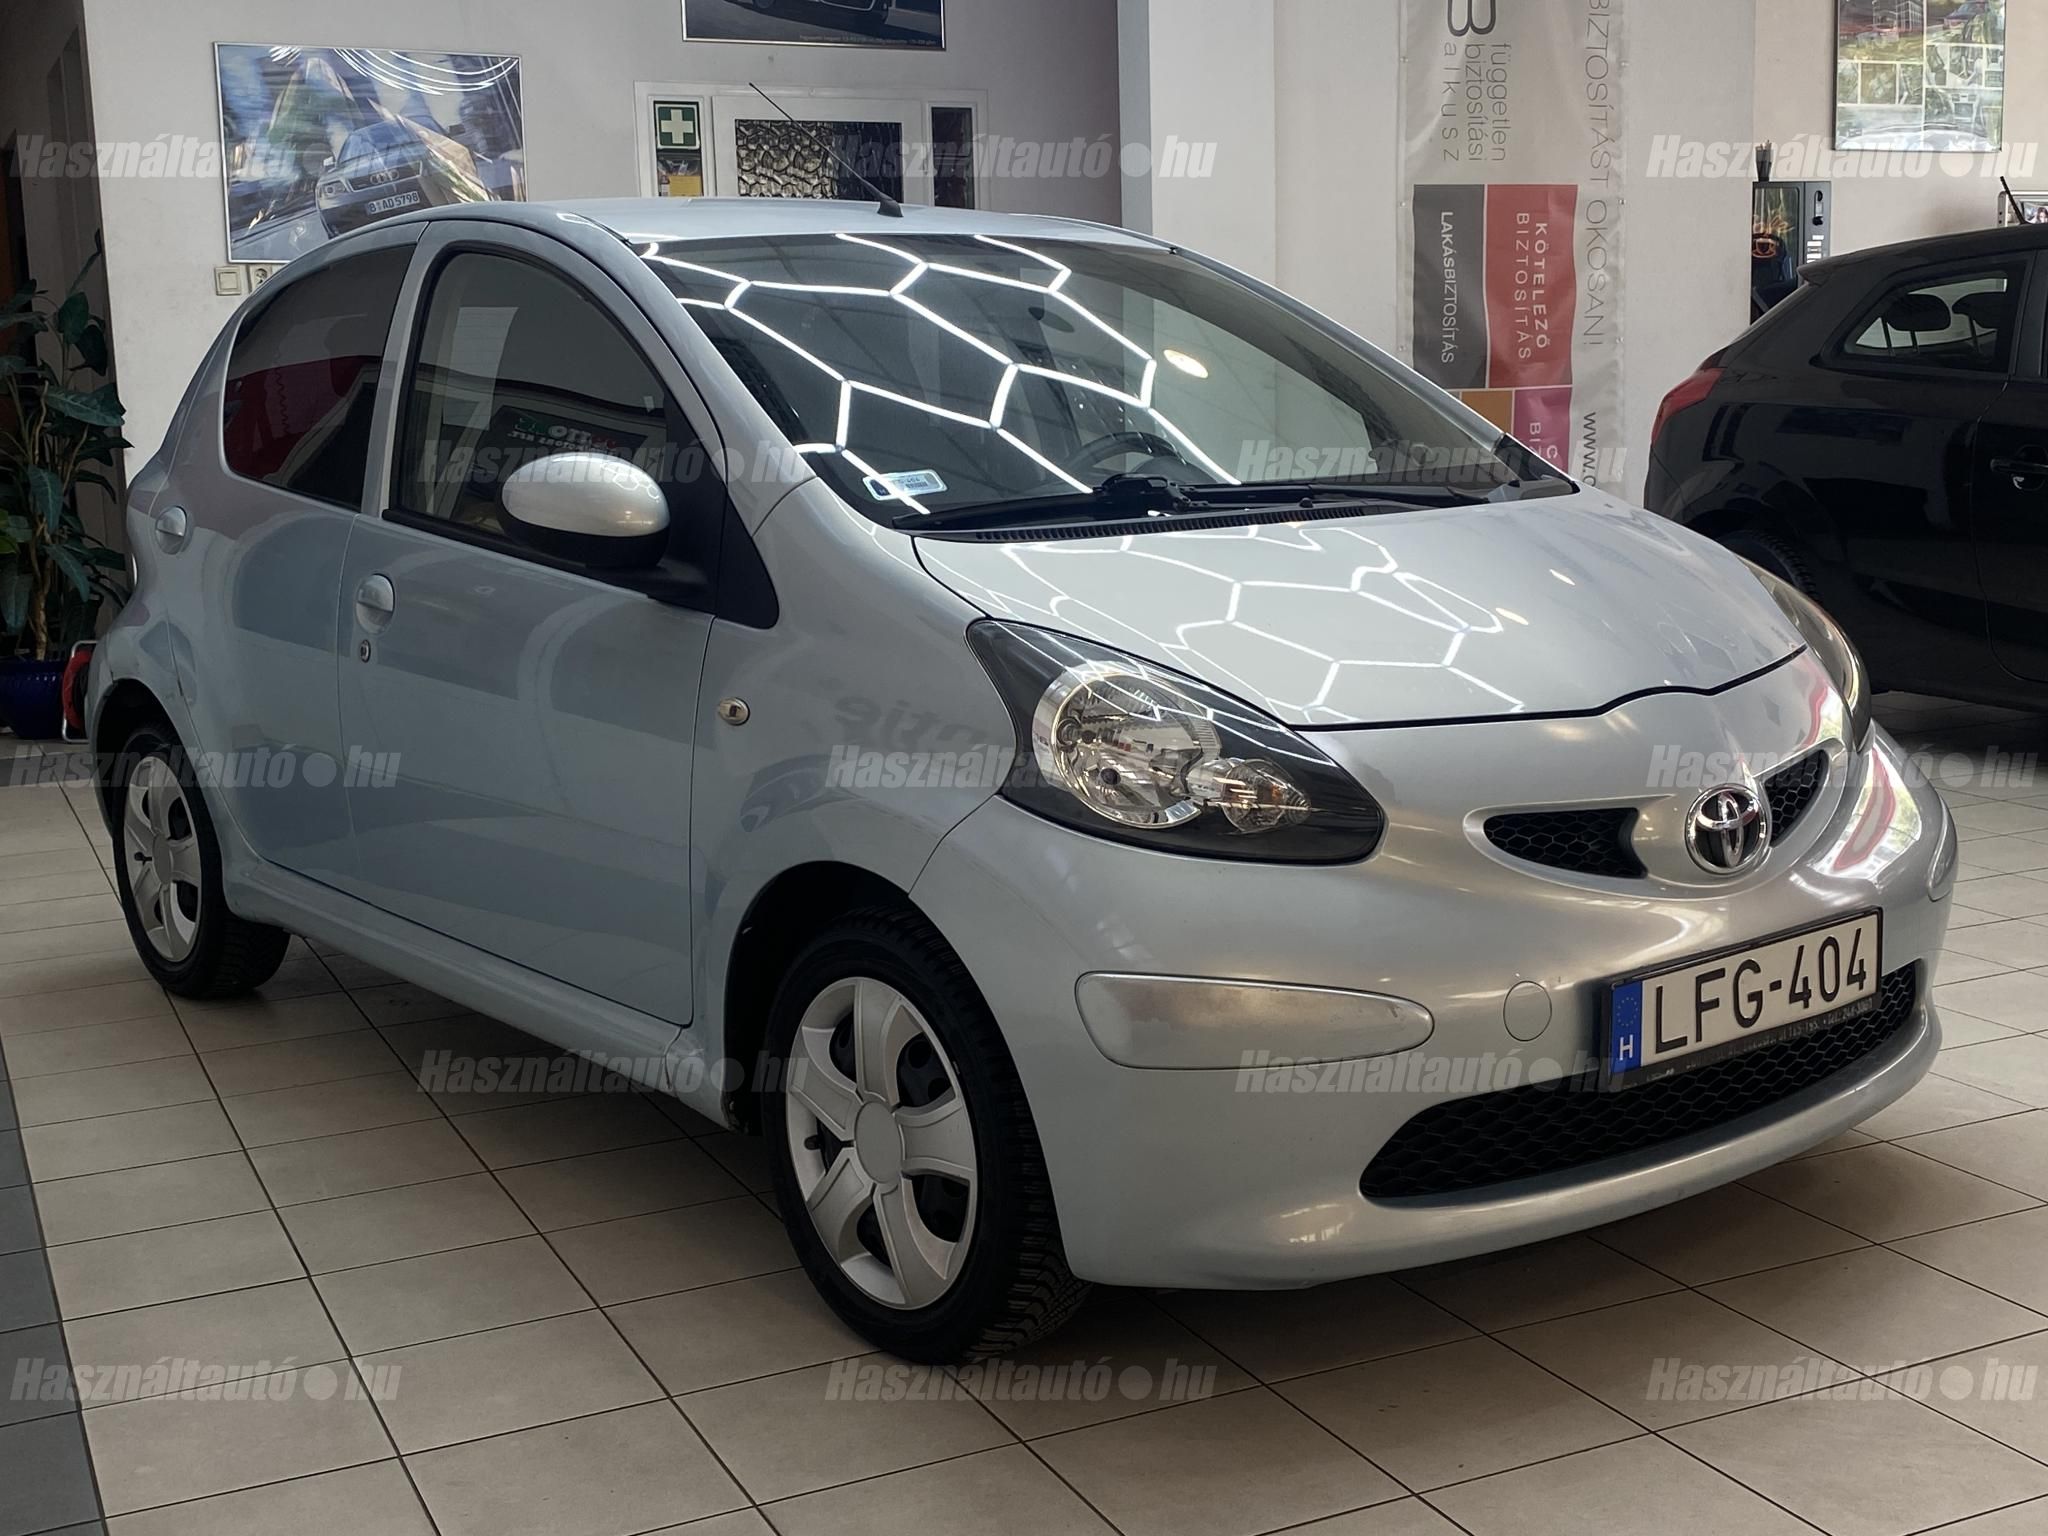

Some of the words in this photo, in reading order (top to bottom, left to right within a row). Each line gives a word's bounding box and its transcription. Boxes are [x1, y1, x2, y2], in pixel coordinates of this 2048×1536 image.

[1465, 44, 1488, 161] biztosítási
[1486, 43, 1511, 161] független
[1440, 211, 1460, 363] LAKÁSBIZTOSÍTÁS
[1514, 212, 1534, 359] BIZTOSÍTÁS
[1532, 222, 1550, 348] KÖTELEZŐ
[1583, 200, 1608, 345] OKOSAN!
[1618, 1034, 1634, 1062] H
[1655, 927, 1867, 1054] LFG-404
